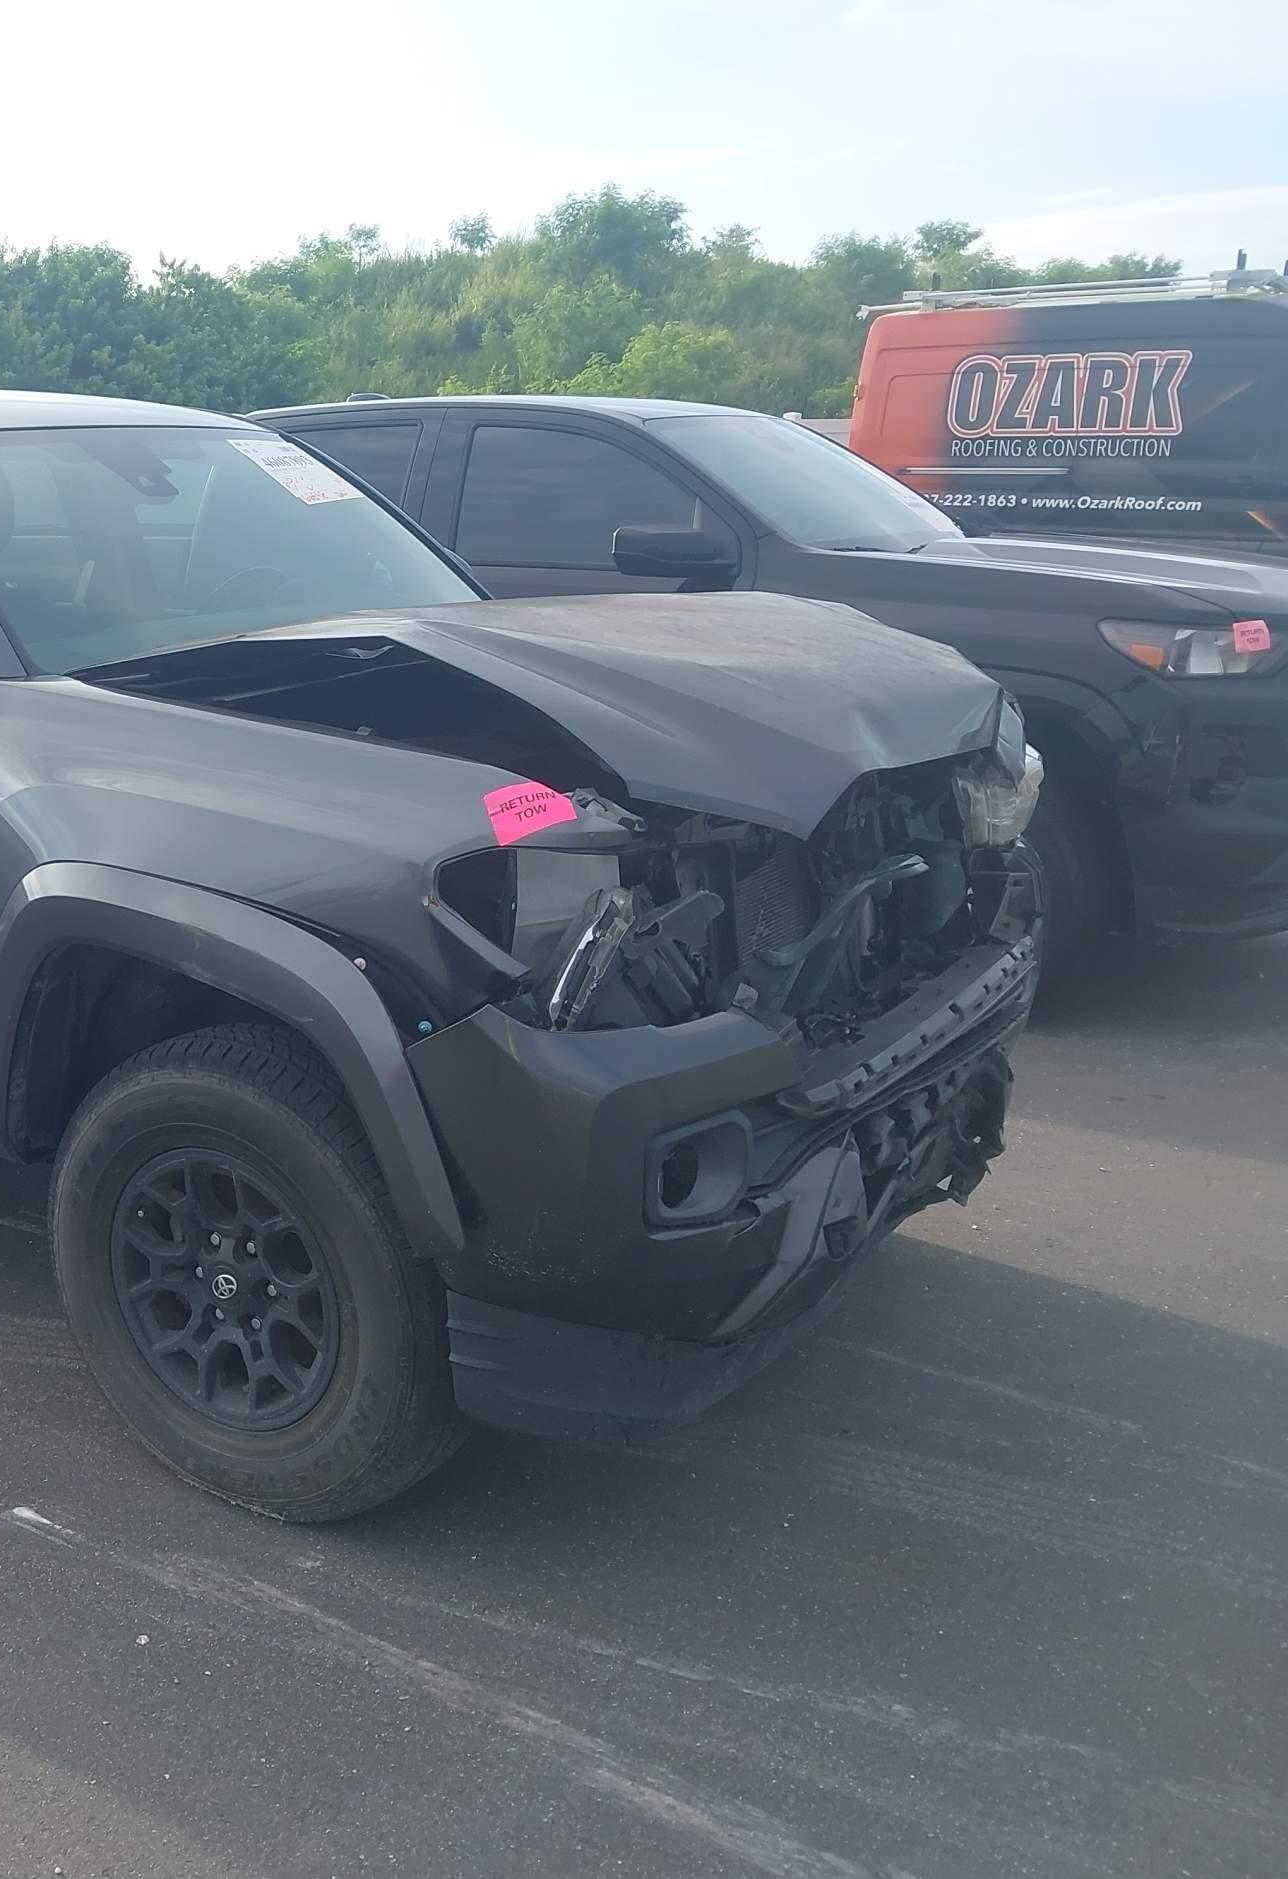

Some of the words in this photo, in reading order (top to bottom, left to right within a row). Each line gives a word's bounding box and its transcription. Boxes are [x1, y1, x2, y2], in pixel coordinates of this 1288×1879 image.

[947, 350, 1192, 438] OZARK
[951, 439, 1022, 457] ROOFING
[1026, 438, 1037, 457] &
[1042, 438, 1171, 457] CONSTRUCTION
[1031, 495, 1202, 512] www.OzarkRoof.com
[499, 791, 557, 813] RETURN
[514, 803, 547, 822] TOW
